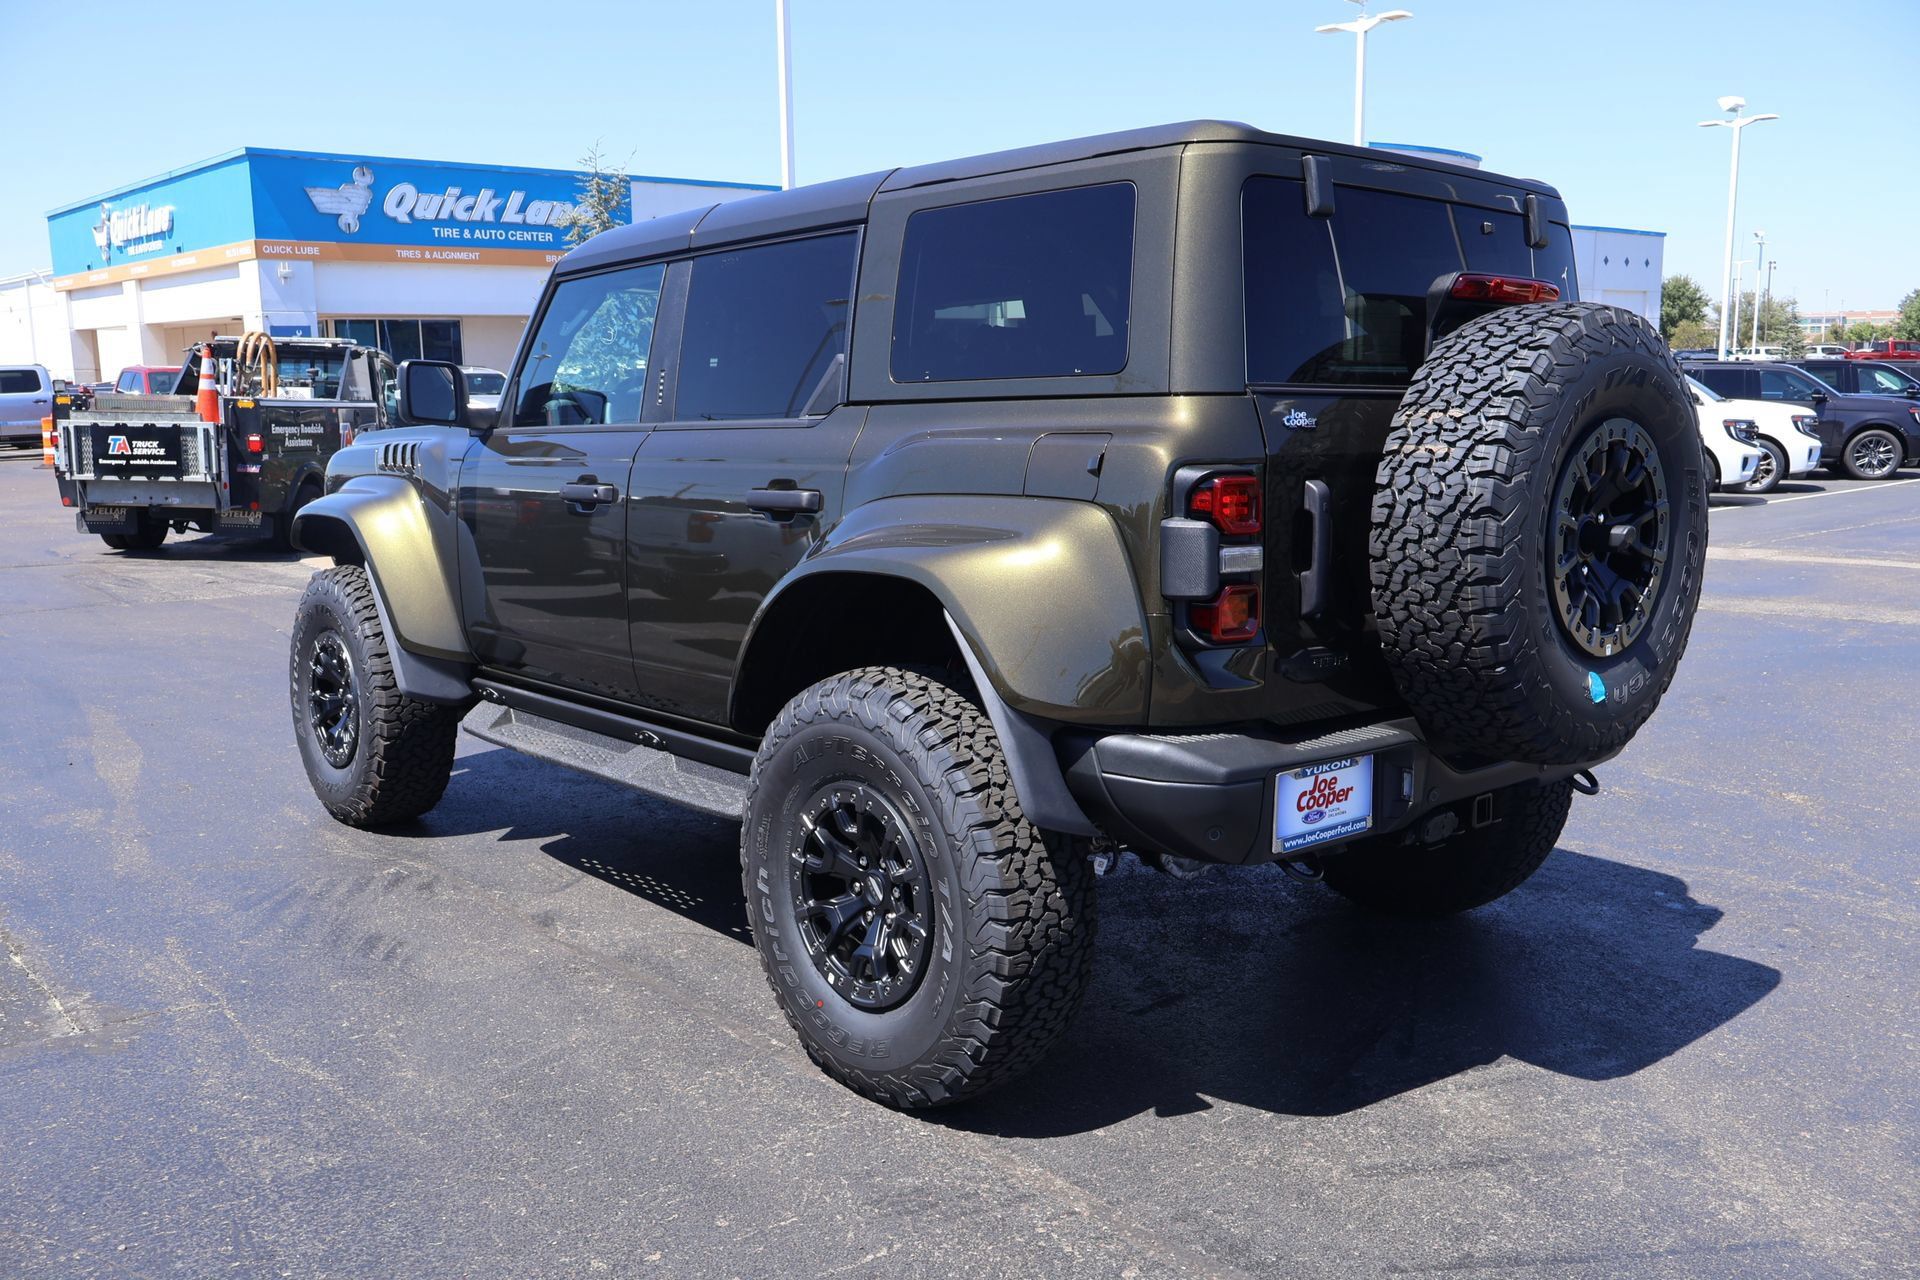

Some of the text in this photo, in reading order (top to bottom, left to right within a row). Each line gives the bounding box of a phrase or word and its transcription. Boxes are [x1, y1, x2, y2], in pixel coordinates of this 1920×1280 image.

[383, 182, 503, 224] Quick
[432, 227, 553, 242] TIRE & AUTO CENTER
[262, 244, 293, 254] QUICK
[294, 245, 320, 255] LUBE
[396, 249, 480, 260] TIRES & ALIGNMENT
[1605, 366, 1648, 392] T/A
[1283, 416, 1317, 427] Cooper
[1291, 409, 1307, 419] Joe
[271, 424, 324, 436] Emergency Roadside
[108, 435, 131, 455] TA
[285, 438, 312, 447] Assistance
[85, 507, 127, 515] STELLAR
[221, 510, 262, 519] STELLAR
[1305, 759, 1351, 776] YUKON
[1309, 774, 1338, 795] Joe
[1297, 786, 1354, 812] Cooper
[1284, 821, 1366, 848] www.JoeCooperFord.com
[937, 877, 953, 963] T/A
[756, 867, 896, 1060] BFGoodrich
